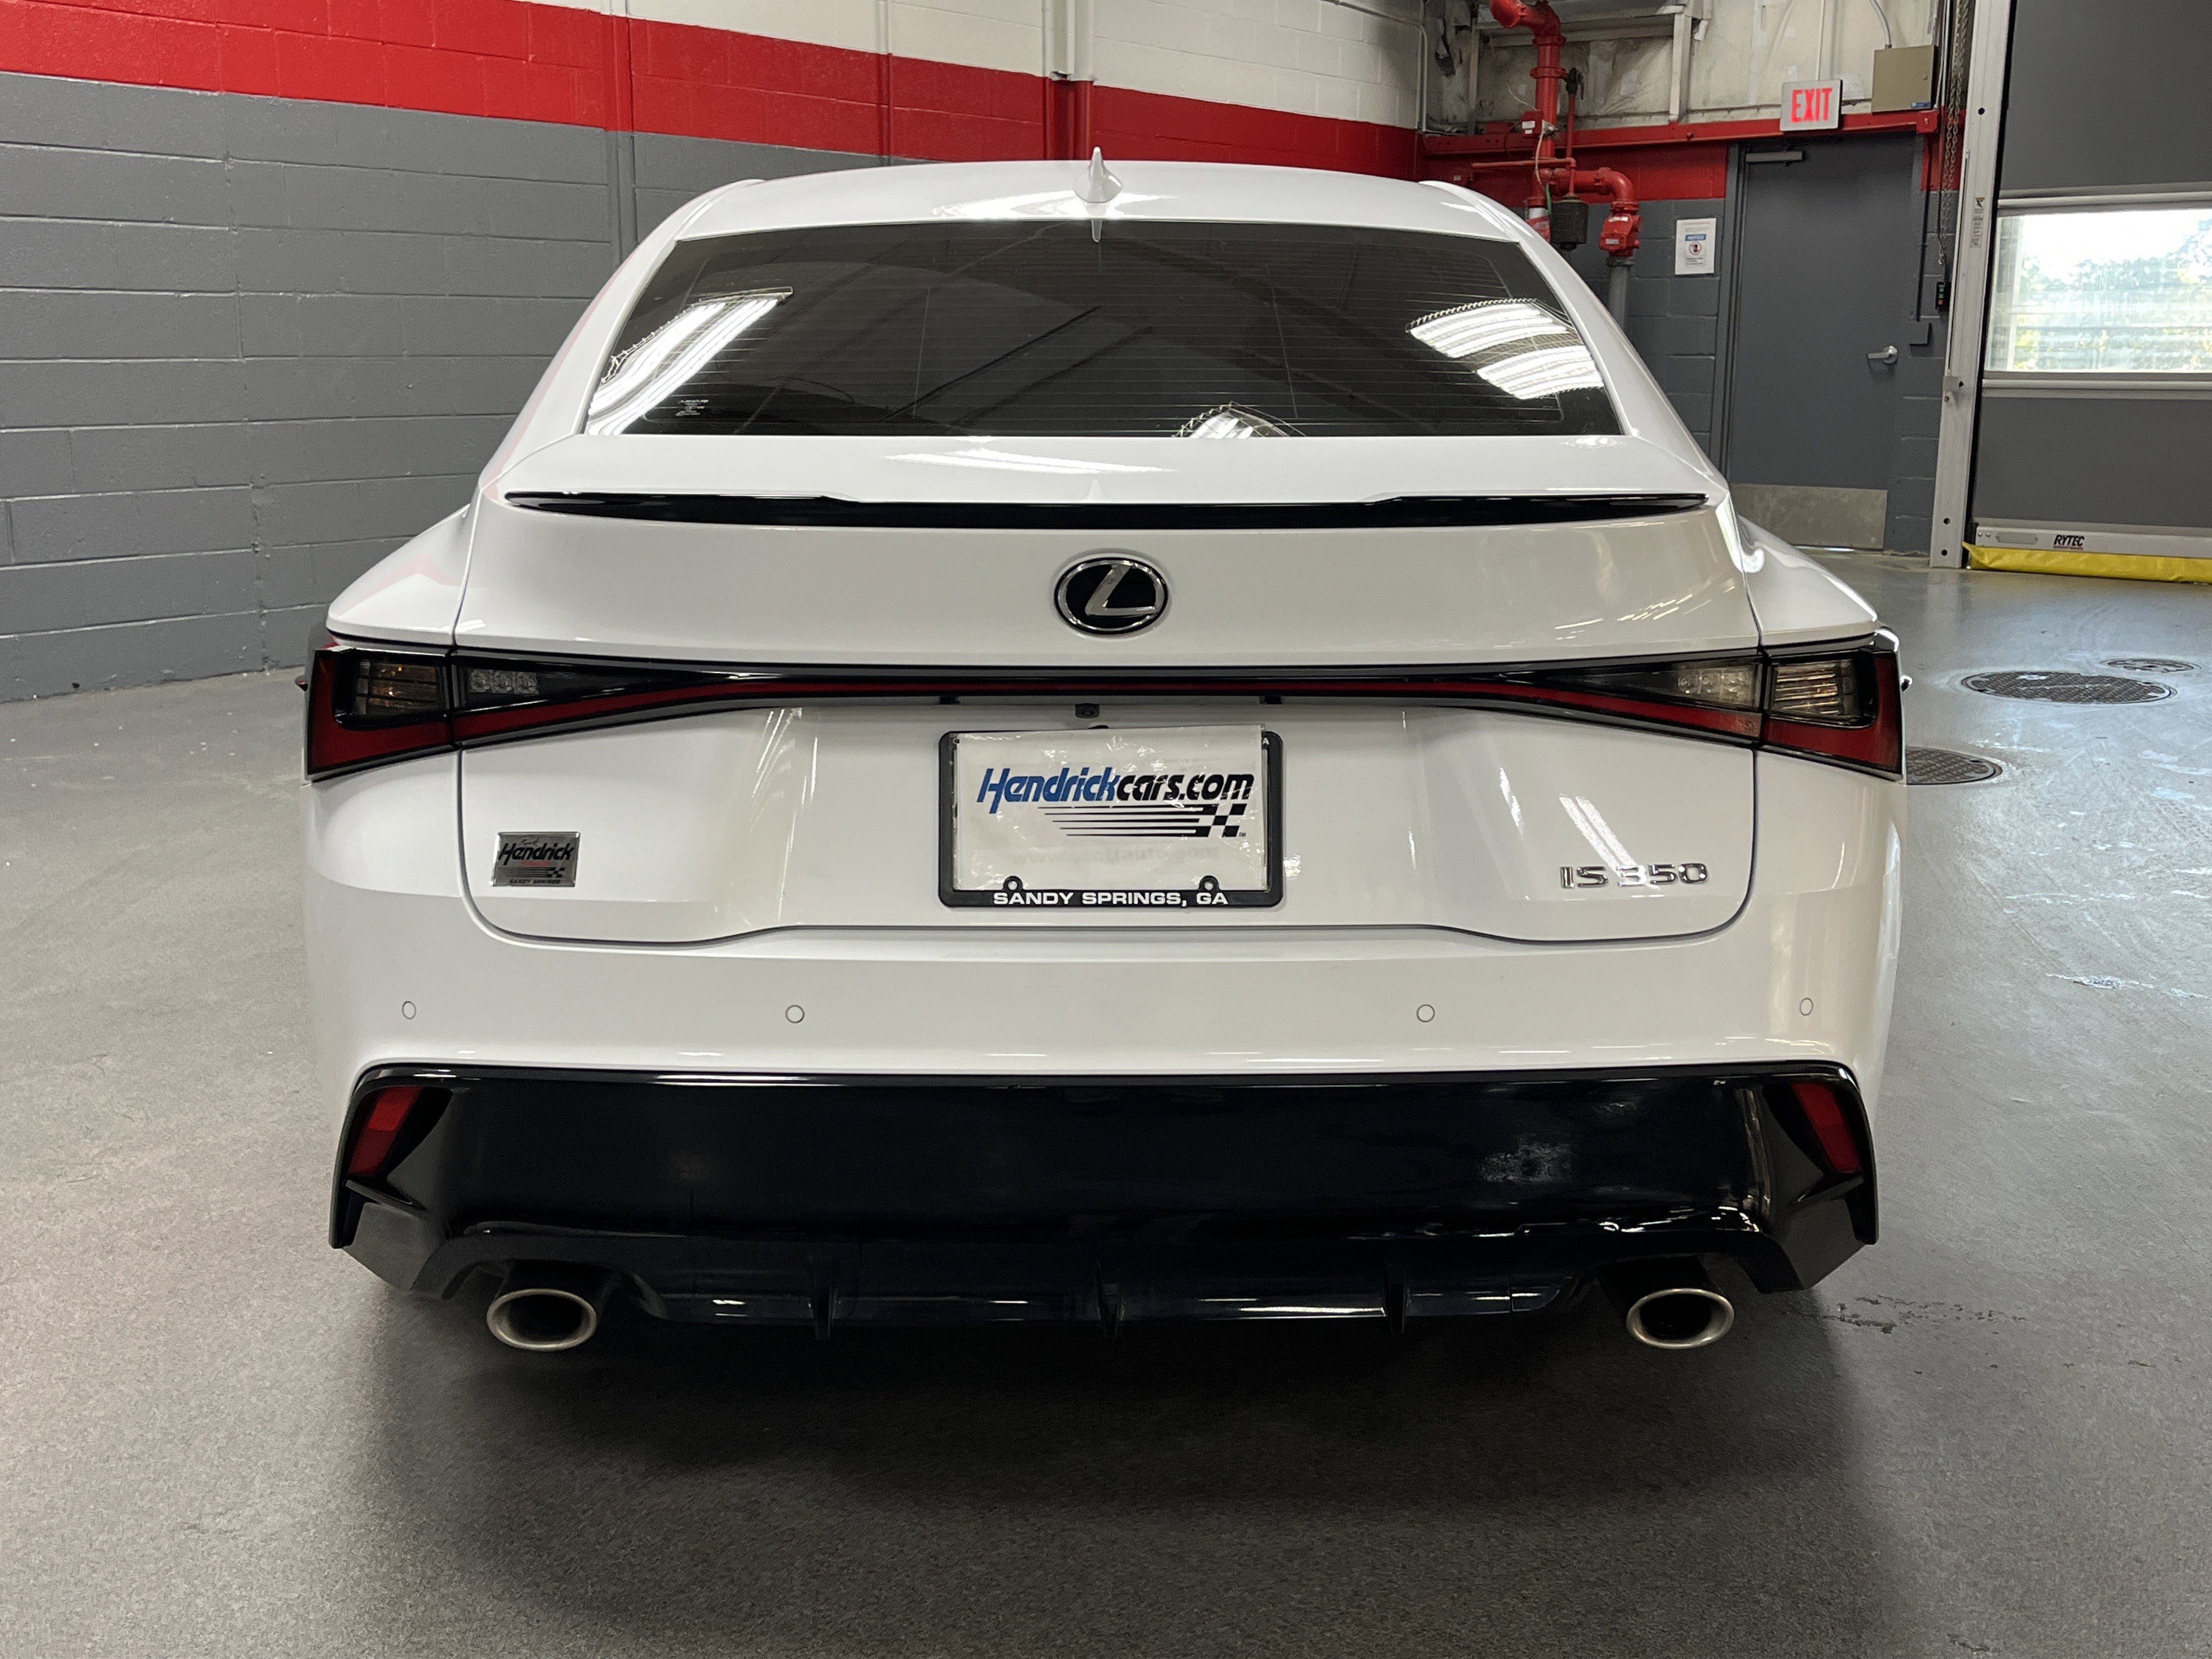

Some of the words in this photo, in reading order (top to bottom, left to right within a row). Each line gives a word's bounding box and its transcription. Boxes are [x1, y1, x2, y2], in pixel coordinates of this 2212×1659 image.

[1790, 88, 1832, 123] EXIT
[2053, 534, 2085, 546] RYTEC
[977, 767, 1255, 814] Hendrickcars.com
[498, 843, 574, 865] Hendrick
[1560, 866, 1609, 888] IS
[1618, 863, 1709, 887] 350
[994, 892, 1074, 905] SANDY
[1082, 891, 1187, 907] SPRINGS,
[1197, 891, 1228, 905] GA
